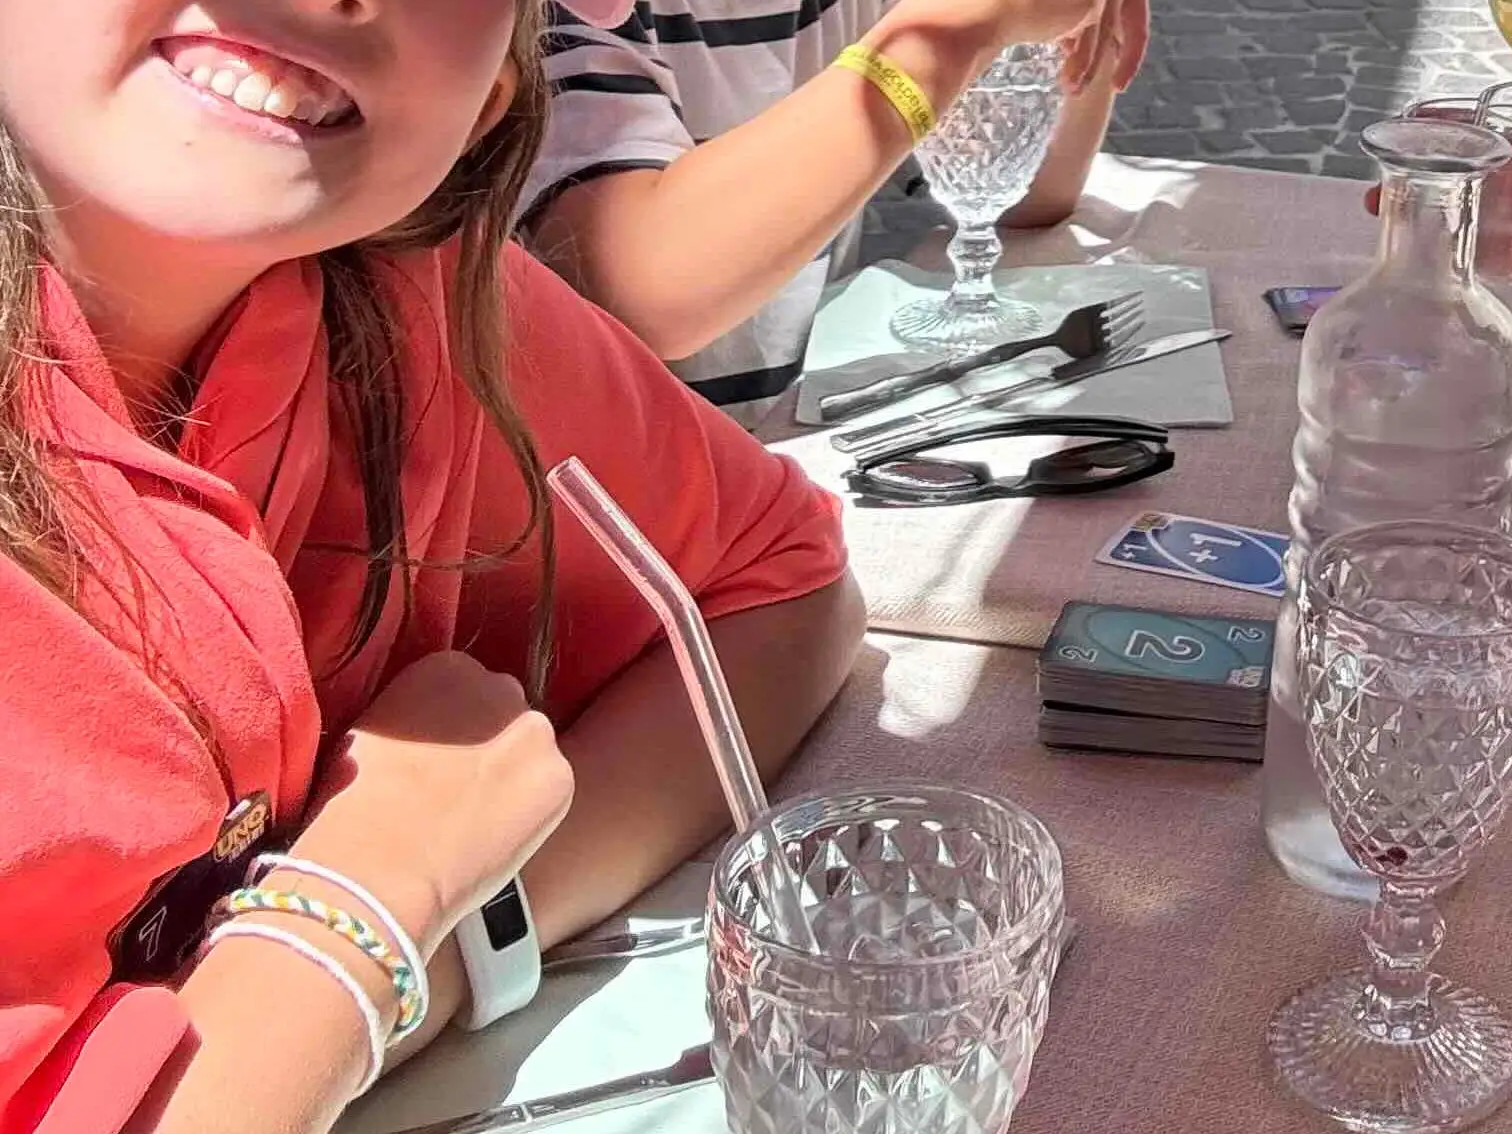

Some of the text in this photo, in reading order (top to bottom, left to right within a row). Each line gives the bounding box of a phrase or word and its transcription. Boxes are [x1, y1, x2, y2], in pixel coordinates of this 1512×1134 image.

[1188, 532, 1243, 564] +1
[1124, 628, 1206, 664] 2
[1227, 625, 1266, 643] 2
[1058, 644, 1098, 664] 2
[214, 803, 268, 860] UNO
